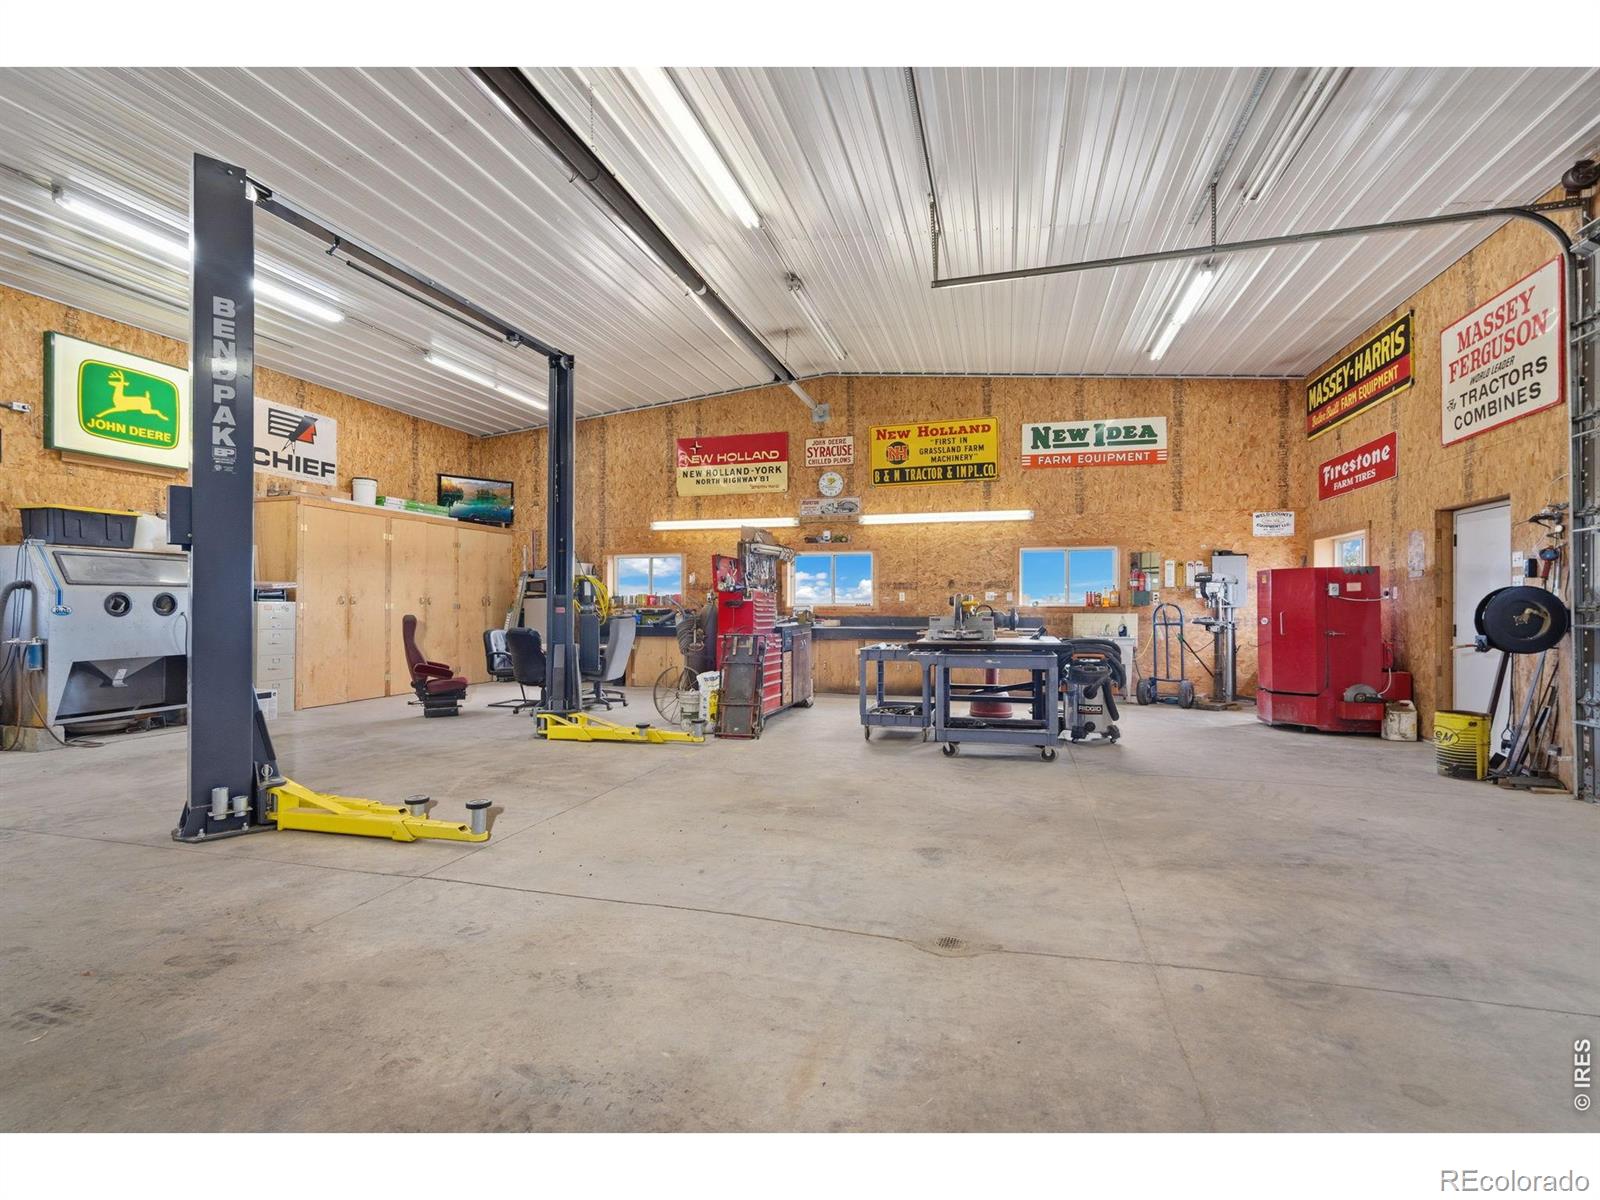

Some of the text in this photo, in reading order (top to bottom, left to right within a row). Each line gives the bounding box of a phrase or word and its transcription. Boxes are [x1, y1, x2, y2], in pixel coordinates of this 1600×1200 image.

[1457, 285, 1536, 353] MASSEY
[1449, 308, 1549, 384] FERGUSON
[212, 296, 237, 447] BENDPAK
[1308, 324, 1405, 411] MASSEY-HARRIS
[1469, 355, 1515, 385] WORLD LEADER
[1340, 390, 1357, 410] FARM
[1359, 365, 1399, 399] EQUIPMENT
[1459, 356, 1548, 408] TRACTORS
[1454, 382, 1542, 430] COMBINES
[87, 418, 172, 442] JOHN DEERE
[875, 424, 991, 440] NEW HOLLAND
[1030, 423, 1158, 449] NEW IDEA
[254, 447, 336, 477] CHIEF
[685, 450, 780, 464] NEW HOLLAND
[807, 444, 852, 458] SYRACUSE
[919, 444, 985, 455] GRASSLAND FARM
[1038, 451, 1151, 465] FARM EQUIPMENT
[682, 466, 783, 478] NEW HOLLAND-YORK
[883, 470, 890, 481] &
[905, 467, 943, 481] TRACTOR
[947, 466, 953, 479] &
[1322, 444, 1391, 486] Firestone
[723, 476, 758, 484] HIGHWAY
[1333, 468, 1376, 491] FARM TIRES
